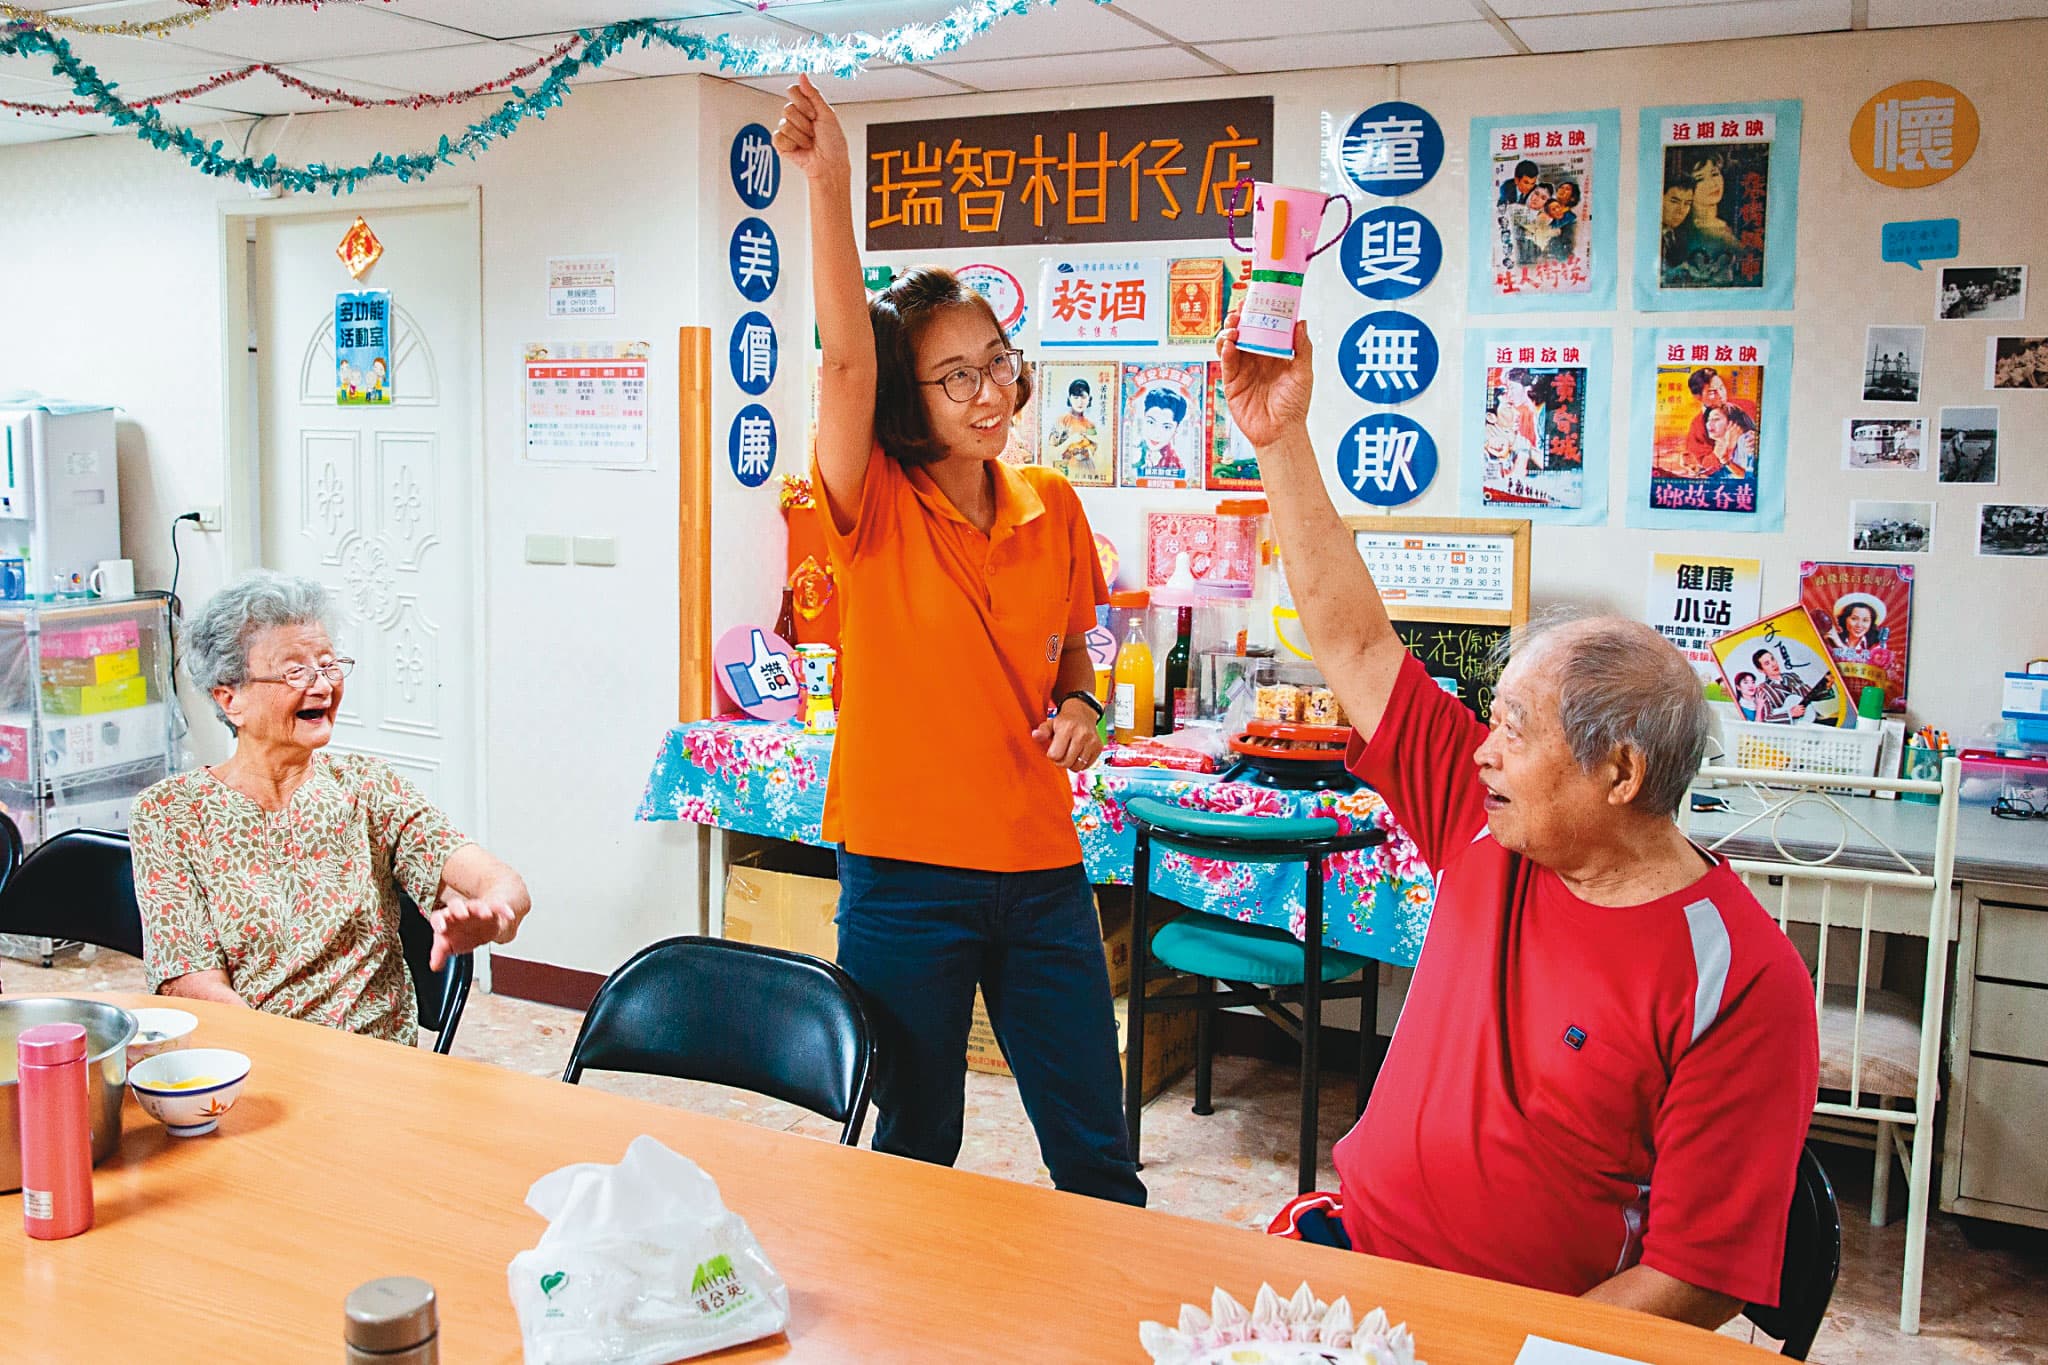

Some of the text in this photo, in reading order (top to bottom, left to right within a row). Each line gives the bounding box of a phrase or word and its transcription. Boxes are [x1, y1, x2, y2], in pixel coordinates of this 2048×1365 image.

[1502, 130, 1585, 150] 近期放映
[1673, 119, 1764, 140] 近期放映
[1874, 96, 1955, 172] 懷
[869, 125, 1260, 232] 瑞智柑仔店
[340, 300, 384, 322] 多功能
[739, 134, 773, 475] 物美價廉
[1052, 279, 1146, 322] 菸酒
[1353, 116, 1424, 493] 童叟無欺
[340, 326, 384, 348] 活動室
[1497, 348, 1580, 363] 近期放映
[1668, 345, 1757, 362] 近期放映
[1677, 564, 1734, 592] 健康
[1674, 598, 1731, 625] 小站
